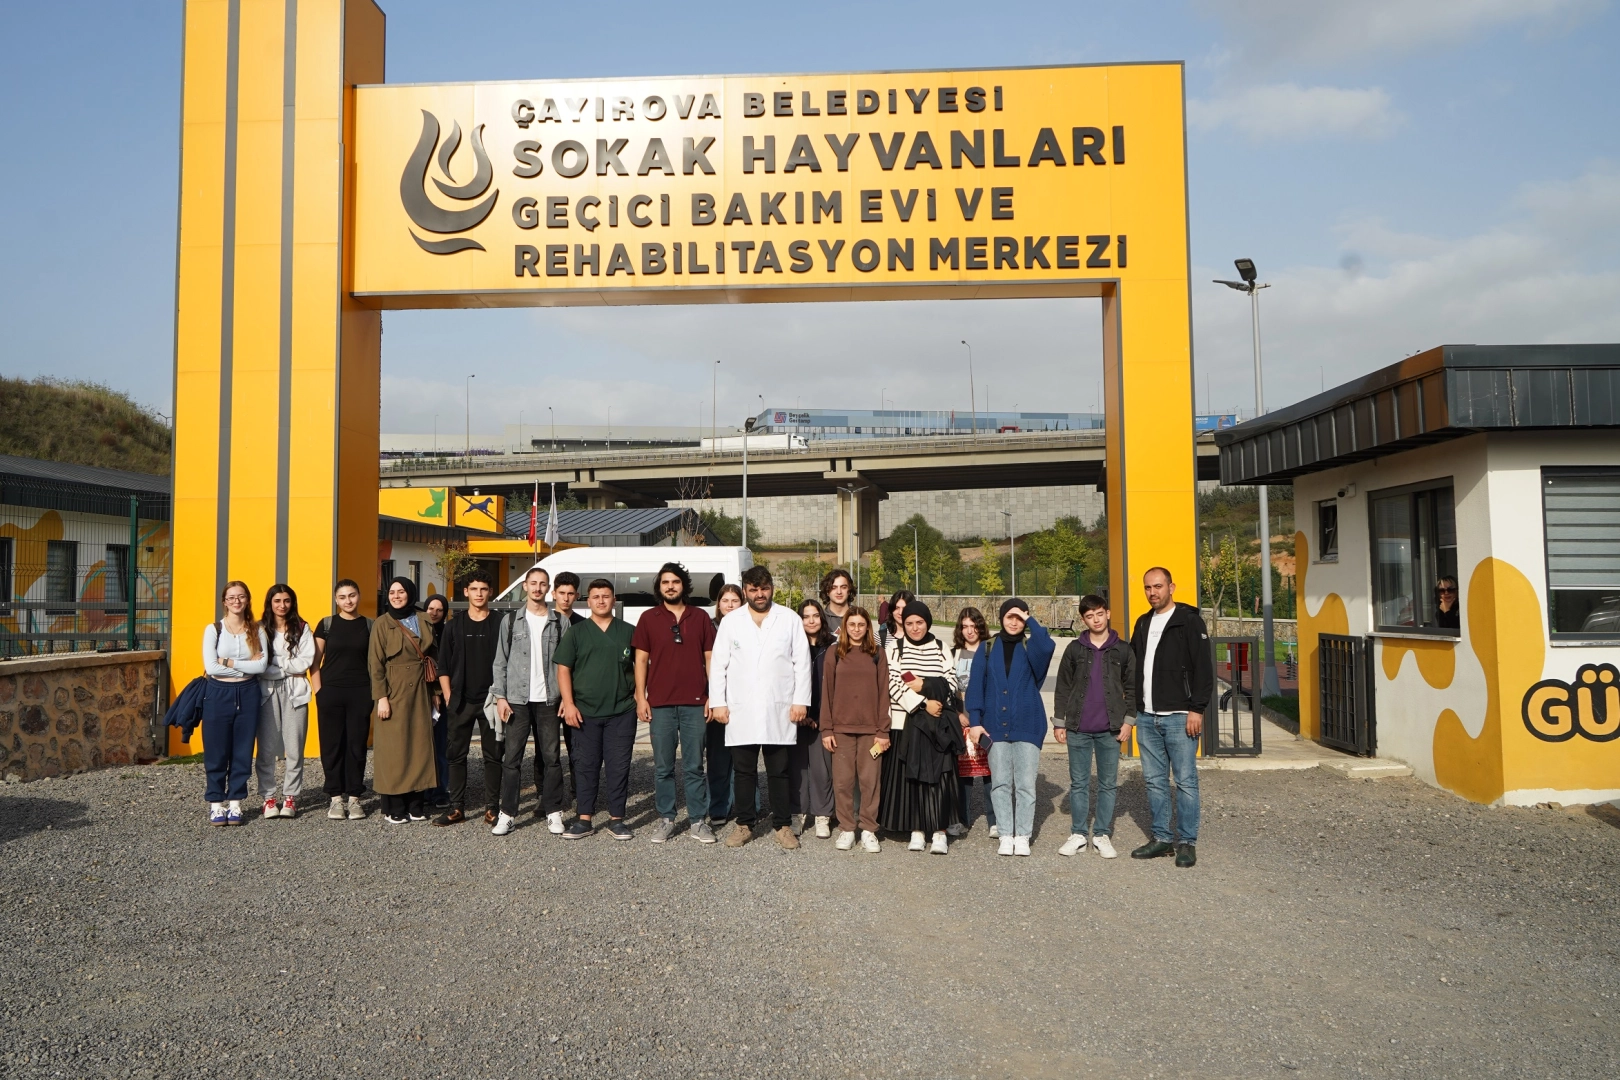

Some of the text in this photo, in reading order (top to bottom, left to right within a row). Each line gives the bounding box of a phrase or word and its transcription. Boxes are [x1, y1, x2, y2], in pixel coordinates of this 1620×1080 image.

[511, 85, 1003, 128] ÇAYIROVA BELEDİYESİ
[512, 125, 1126, 178] SOKAK HAYVANLARI
[511, 186, 1015, 232] GEÇİCİ BAKIM EVİ VE
[514, 234, 1128, 277] REHABİLİTASYON MERKEZİ
